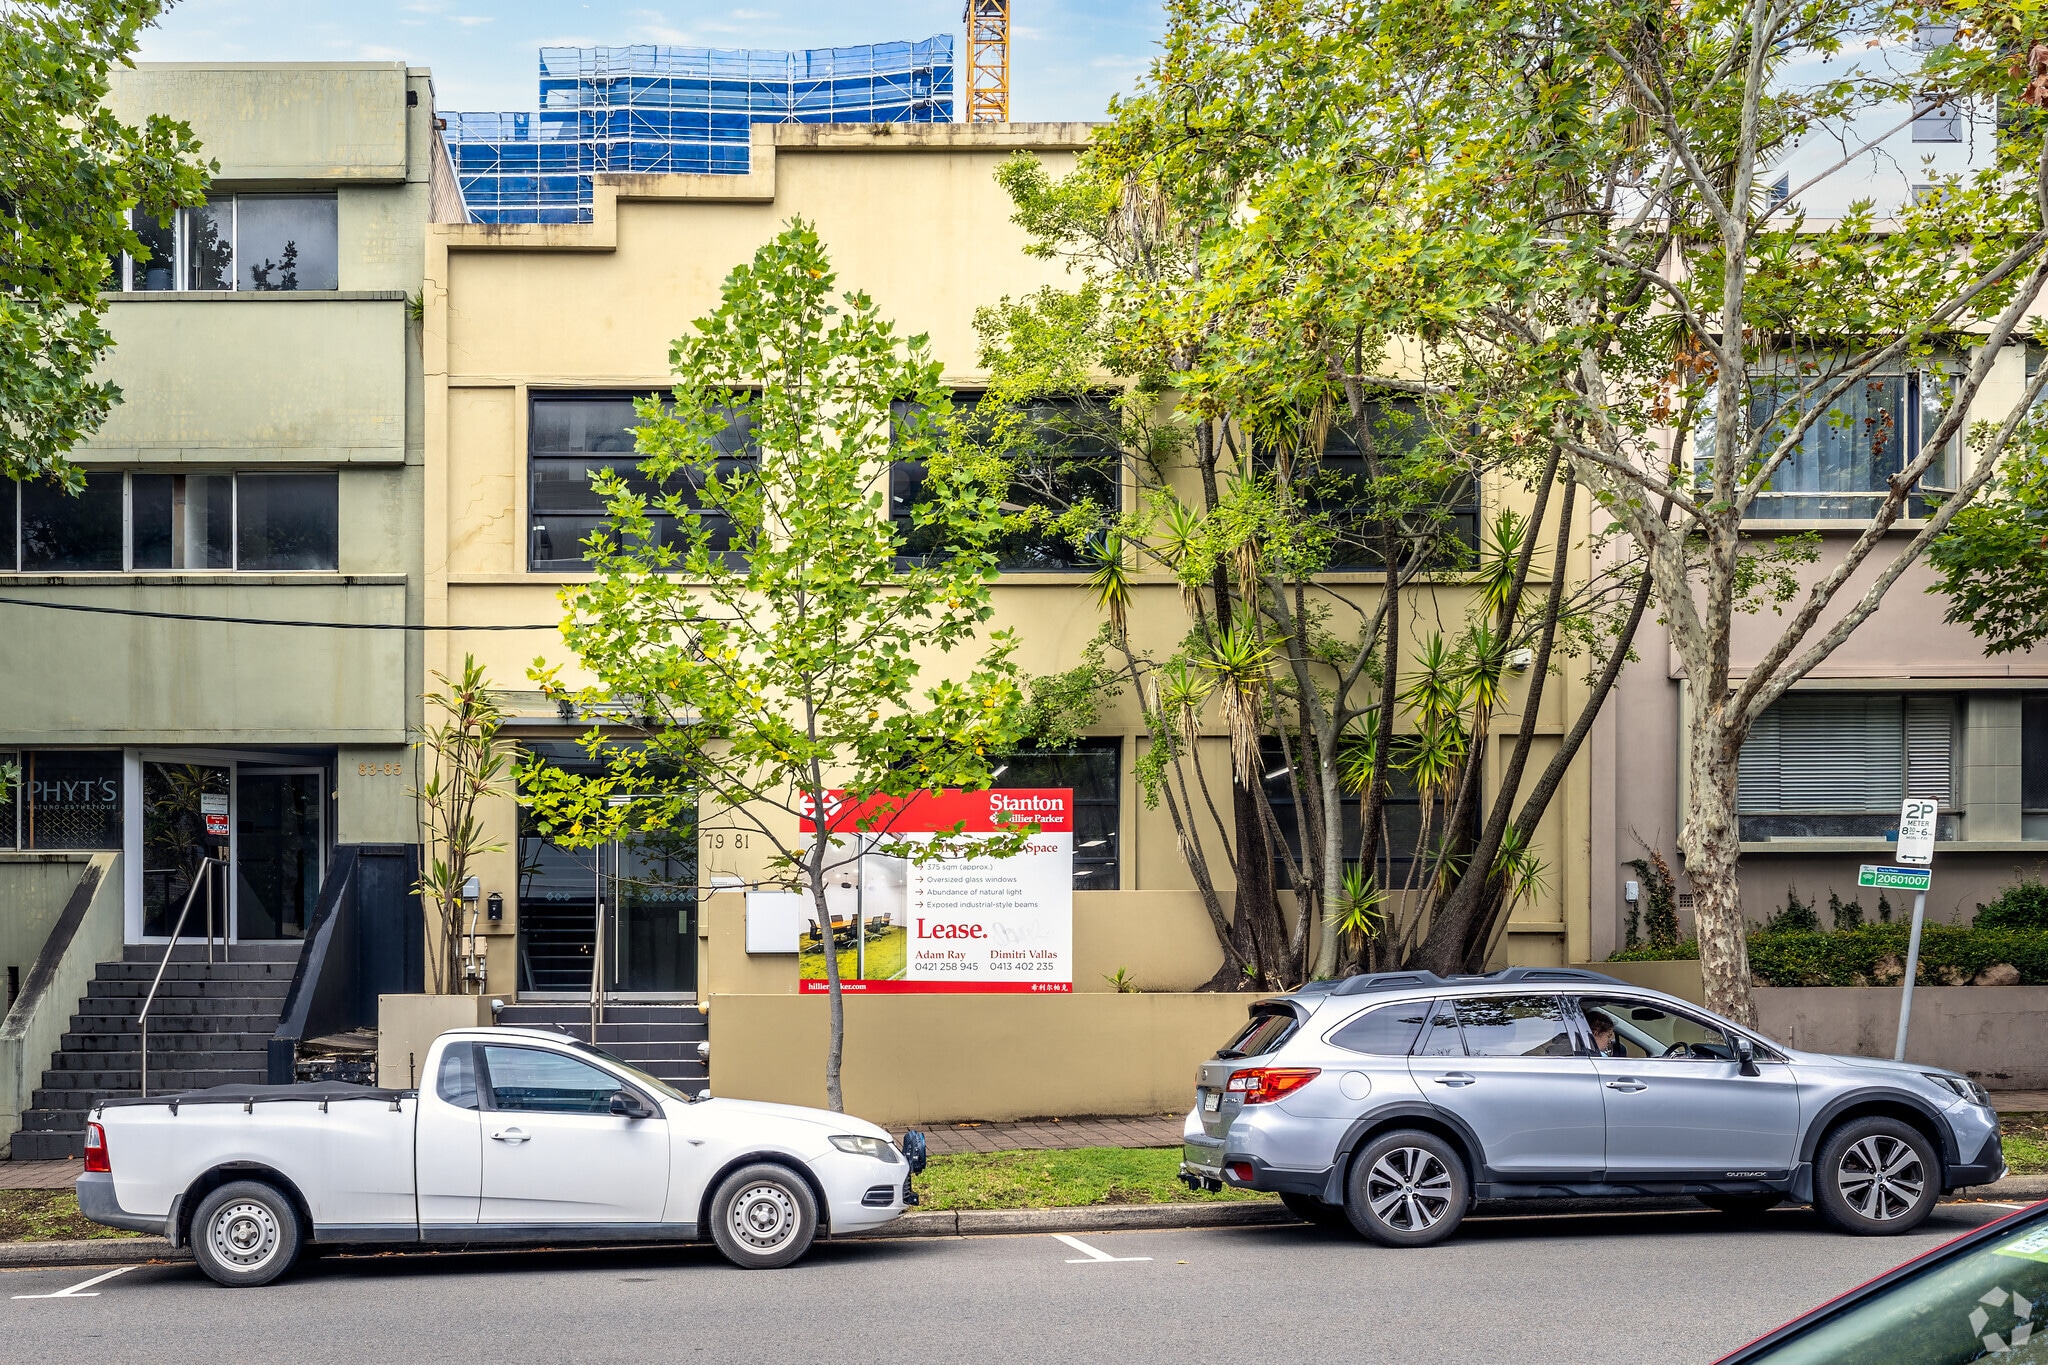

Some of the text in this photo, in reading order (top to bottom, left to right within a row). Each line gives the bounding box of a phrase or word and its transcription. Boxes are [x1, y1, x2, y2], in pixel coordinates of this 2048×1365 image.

[358, 763, 402, 776] 83-85
[27, 777, 117, 801] PHYT'S
[989, 794, 1064, 811] Stanton
[1906, 804, 1934, 819] 2P
[1004, 814, 1064, 823] illier Parker
[705, 834, 749, 849] 79 81
[1026, 842, 1058, 855] Space
[927, 863, 940, 871] 375
[960, 863, 993, 872] (approx.)
[965, 876, 984, 884] glass
[1877, 874, 1928, 886] 20601007
[1006, 889, 1022, 897] light
[927, 901, 958, 909] Exposed
[960, 901, 1013, 909] industrial-style
[916, 918, 988, 939] Lease.
[915, 950, 966, 961] Adam Ray
[990, 950, 1058, 959] Dimitri Vallas
[915, 962, 979, 971] 0421 258 945
[990, 962, 1054, 971] 0413 402 235
